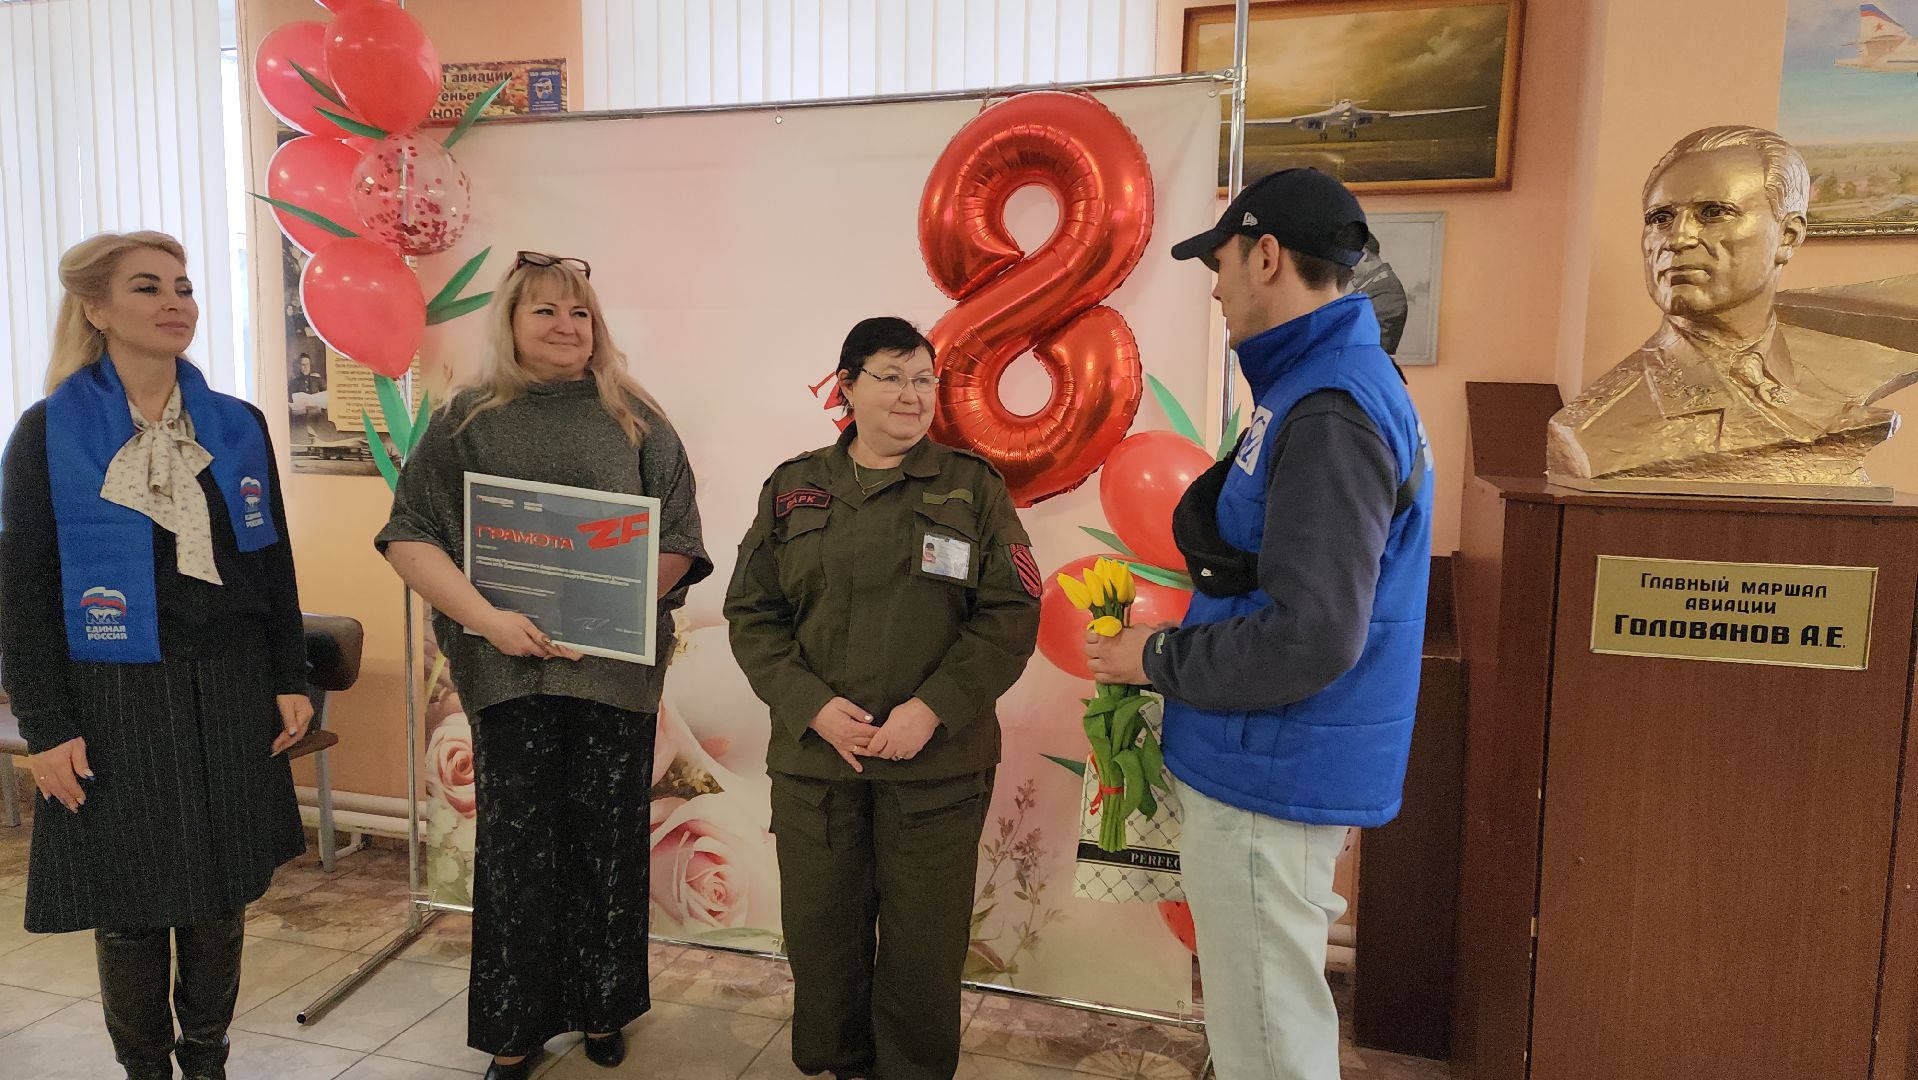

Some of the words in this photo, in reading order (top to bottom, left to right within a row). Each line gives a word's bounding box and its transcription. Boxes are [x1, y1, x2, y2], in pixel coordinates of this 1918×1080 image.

[452, 71, 513, 84] авиации
[918, 89, 1154, 508] 8
[476, 525, 575, 552] ГРАМОТА
[86, 625, 126, 634] ЕДИНАЯ
[87, 632, 128, 641] РОССИЯ
